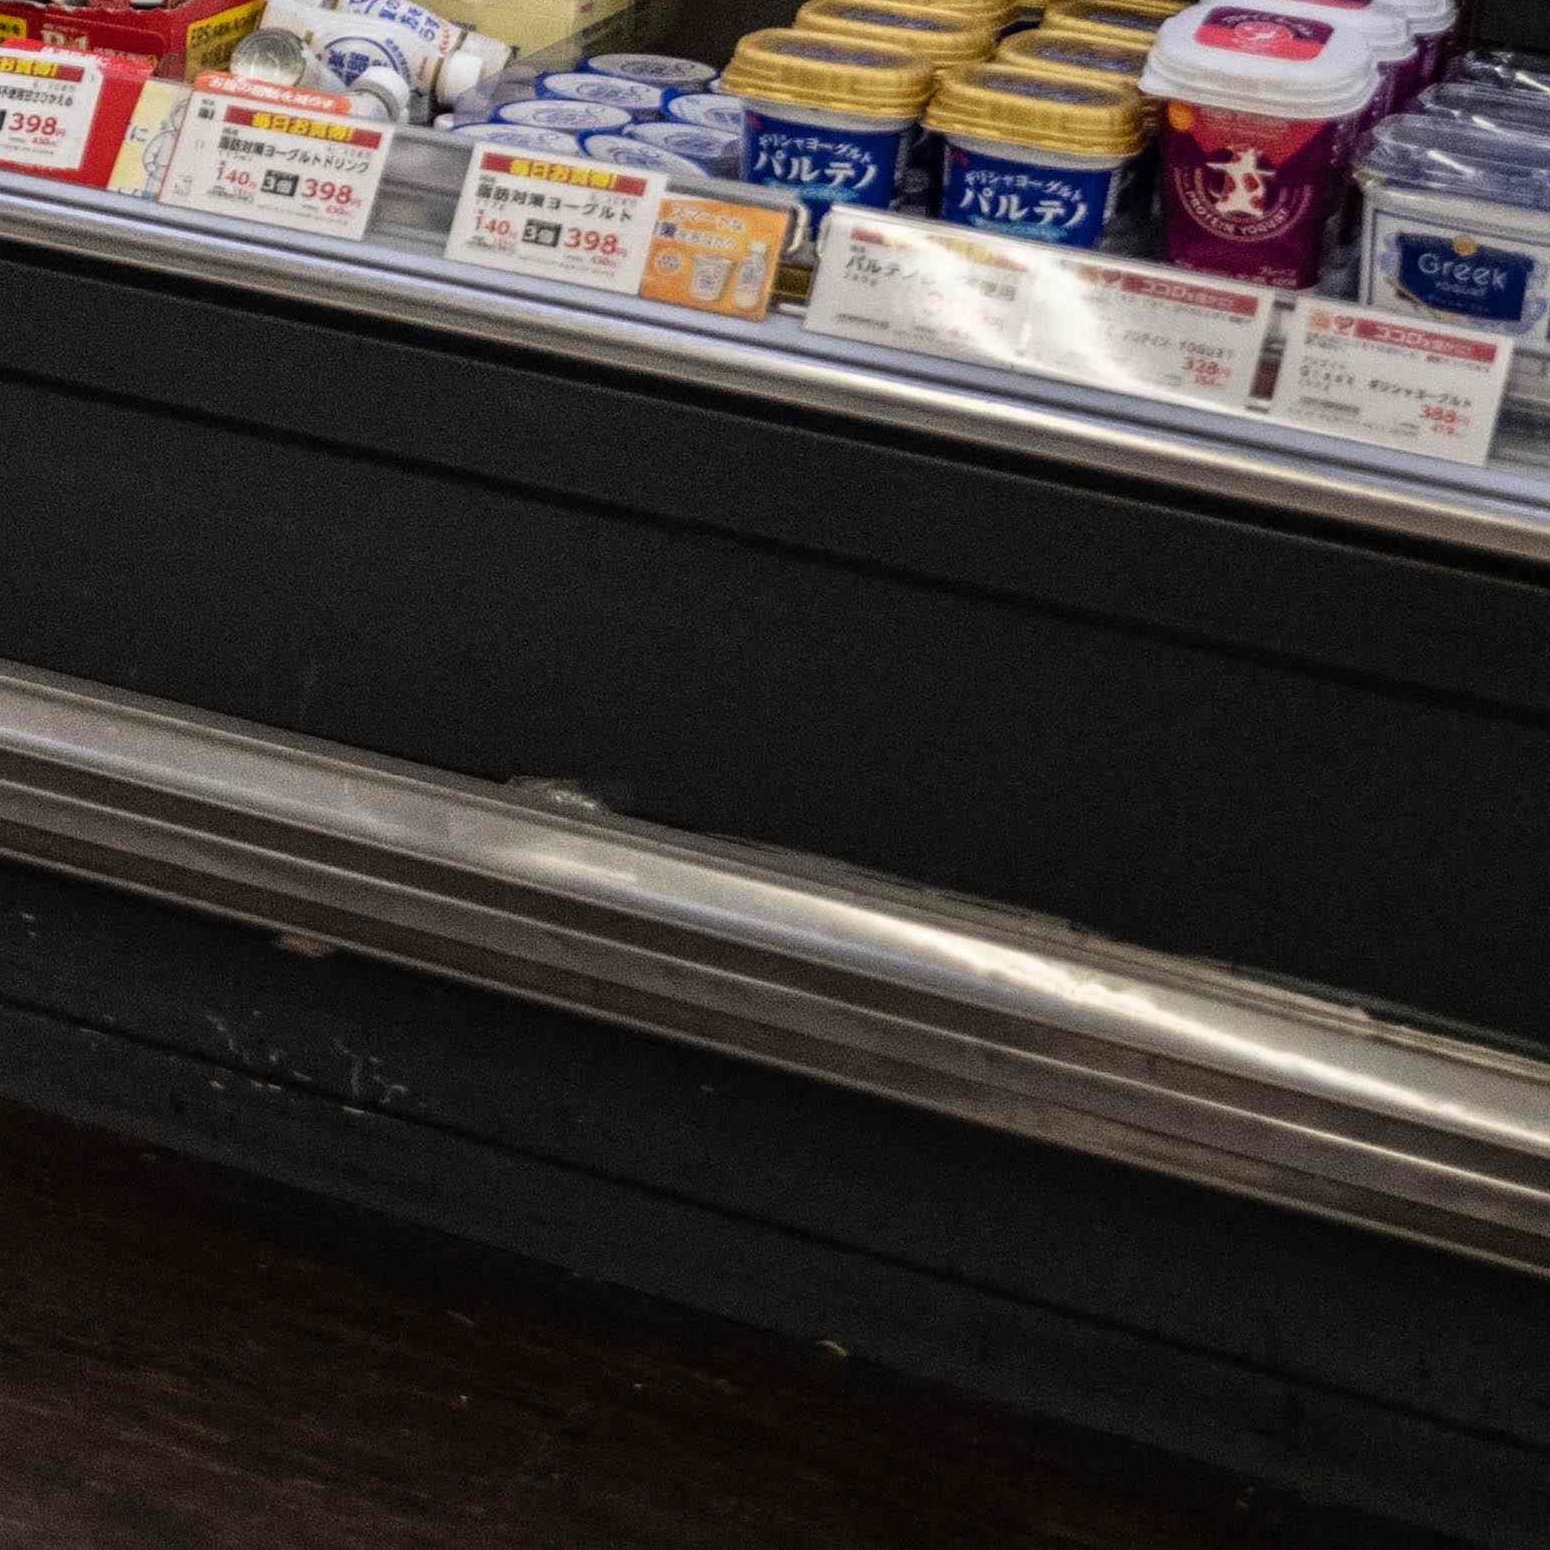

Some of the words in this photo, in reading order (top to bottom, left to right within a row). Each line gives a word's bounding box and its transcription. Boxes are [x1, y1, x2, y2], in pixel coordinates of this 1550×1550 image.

[753, 150, 877, 190] パルテノ
[959, 189, 1087, 227] パルテノ
[1417, 252, 1507, 292] Greek
